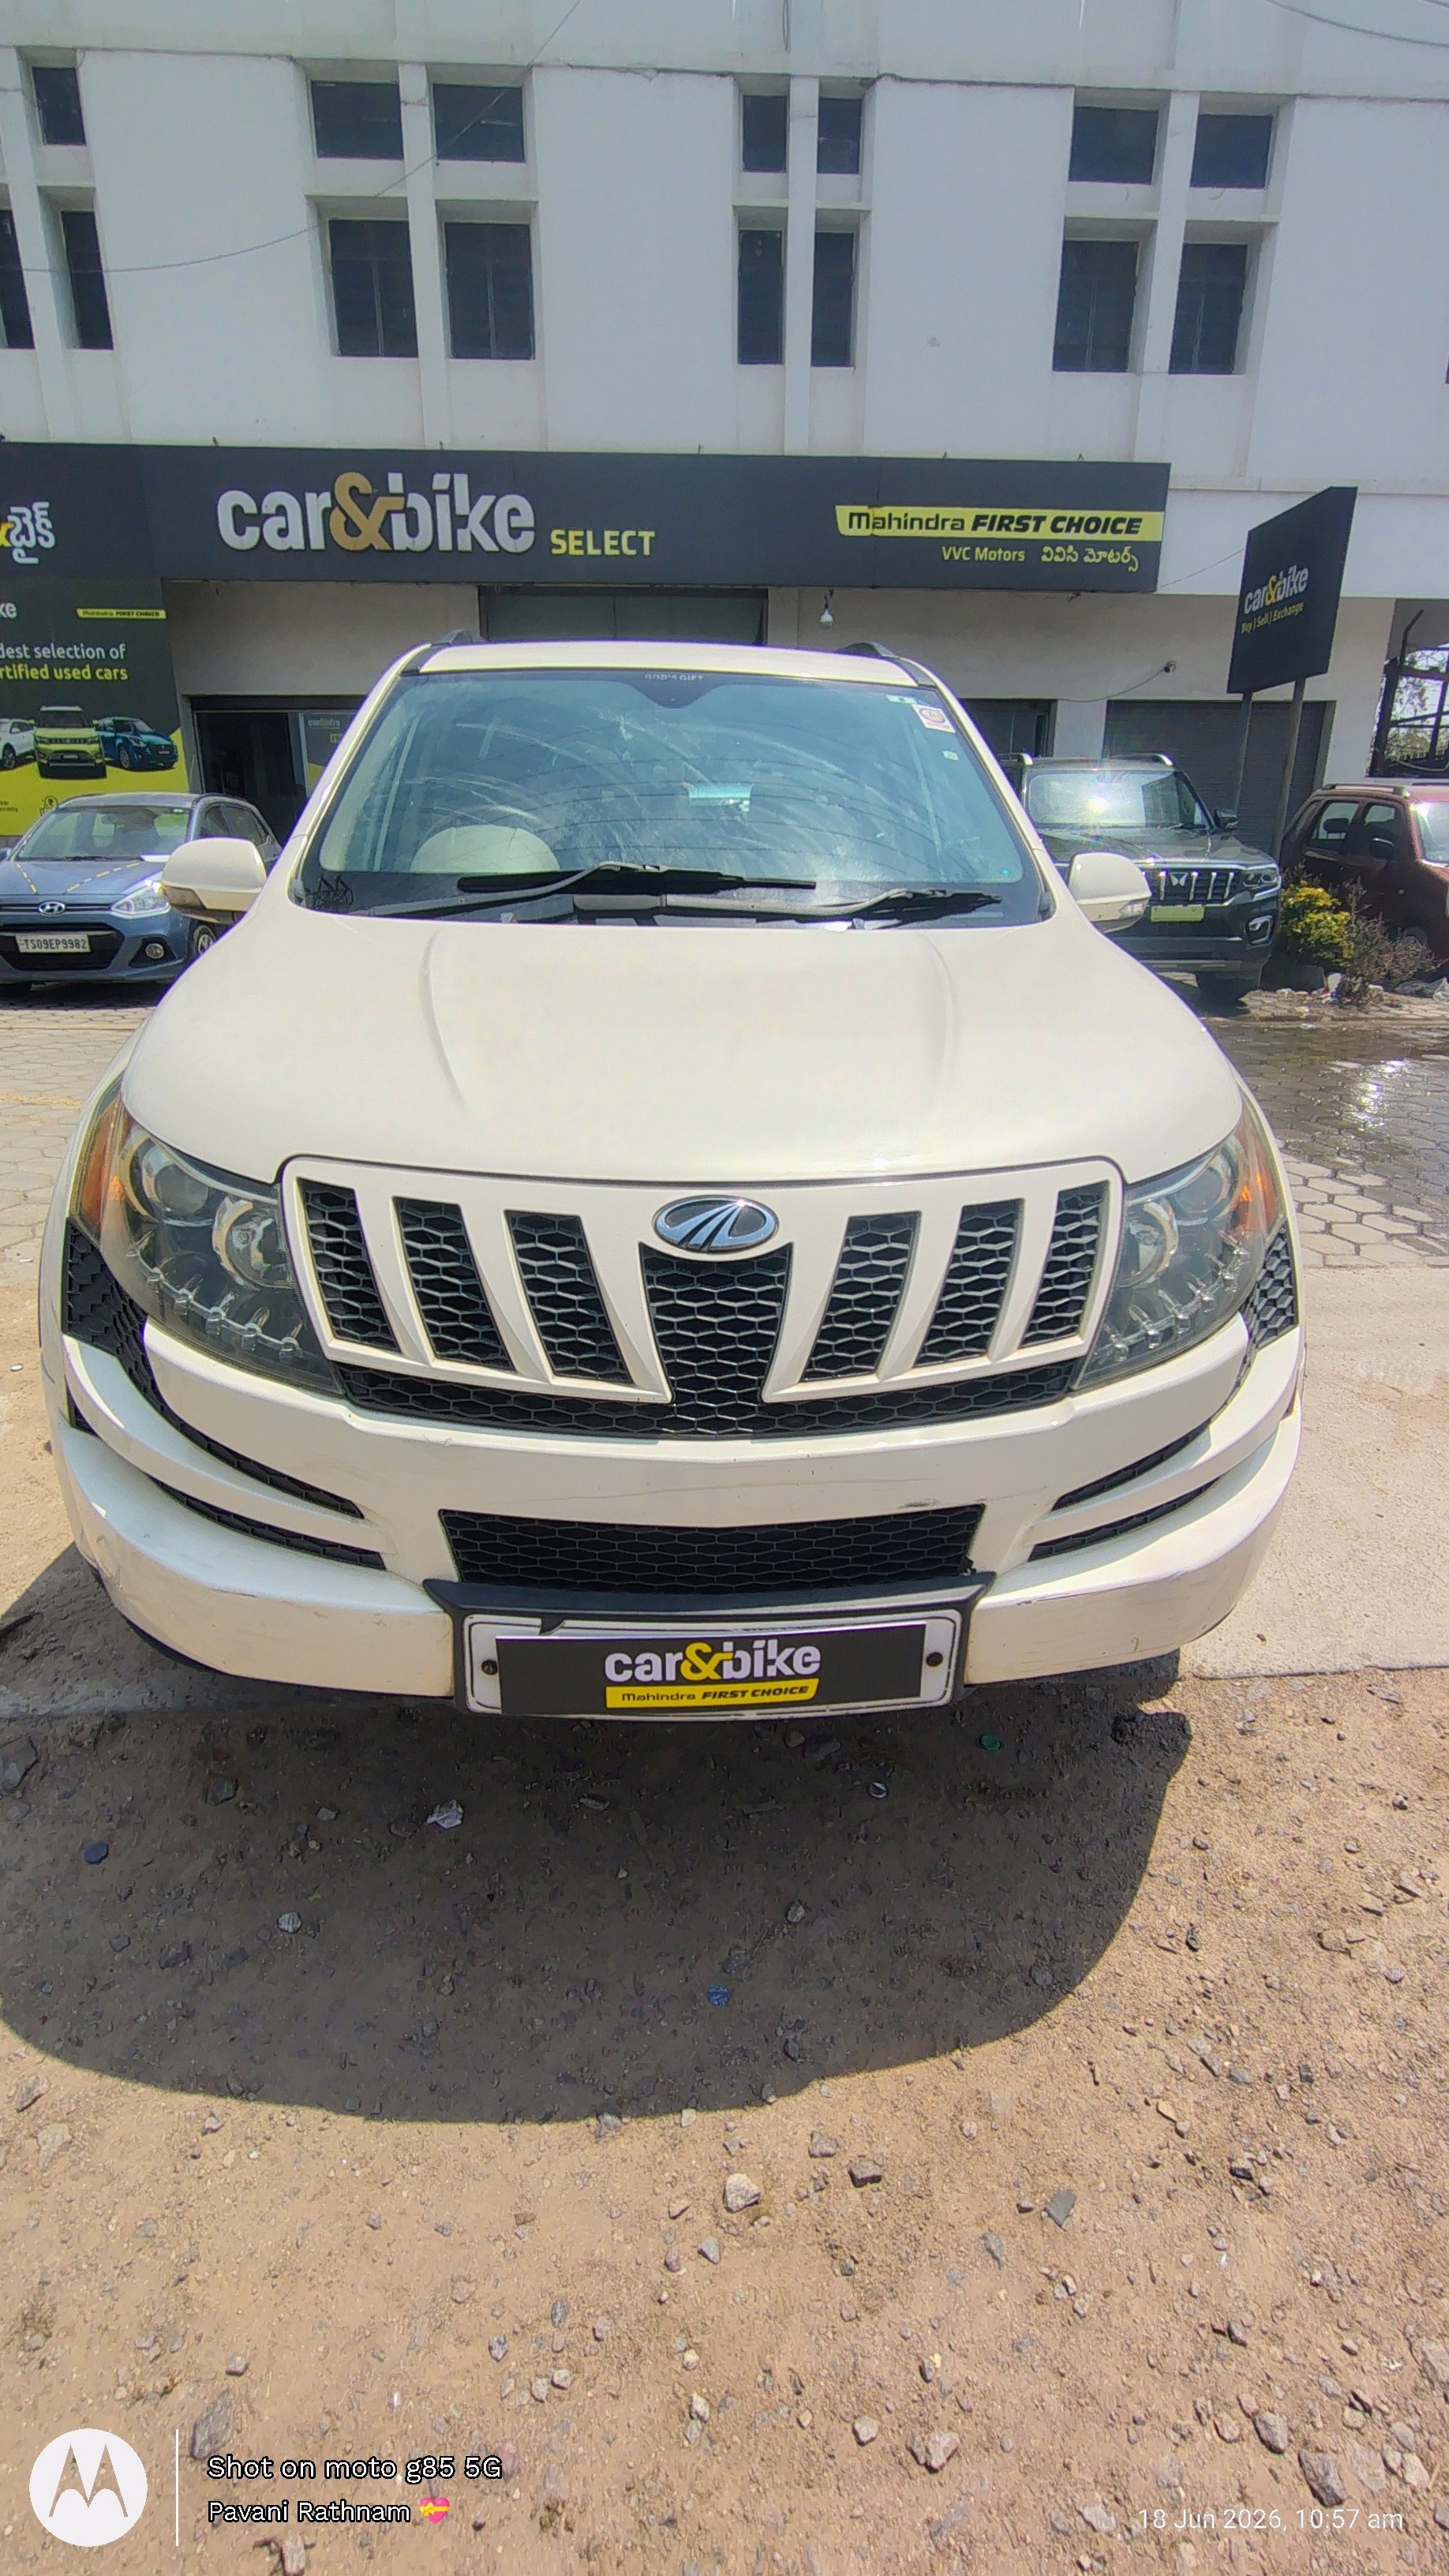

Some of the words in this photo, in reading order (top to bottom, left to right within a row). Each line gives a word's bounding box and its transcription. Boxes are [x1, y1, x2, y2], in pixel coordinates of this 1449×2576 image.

[217, 472, 536, 552] car&bike
[550, 528, 655, 556] SELECT
[848, 511, 965, 531] Mahindra
[971, 515, 1046, 534] FIRST
[1050, 516, 1143, 535] CHOICE
[942, 546, 972, 561] VVC
[975, 546, 1026, 563] Motors
[1245, 565, 1309, 615] car&bike
[1272, 601, 1304, 621] Exchange
[34, 642, 106, 660] selection
[109, 643, 126, 660] of
[53, 664, 92, 680] used
[95, 668, 129, 680] cars
[24, 938, 87, 950] TS09EP9982
[605, 1639, 821, 1682] car&bike
[621, 1693, 696, 1702] Mahindra
[702, 1690, 749, 1700] FIRST
[751, 1686, 809, 1697] CHOICE
